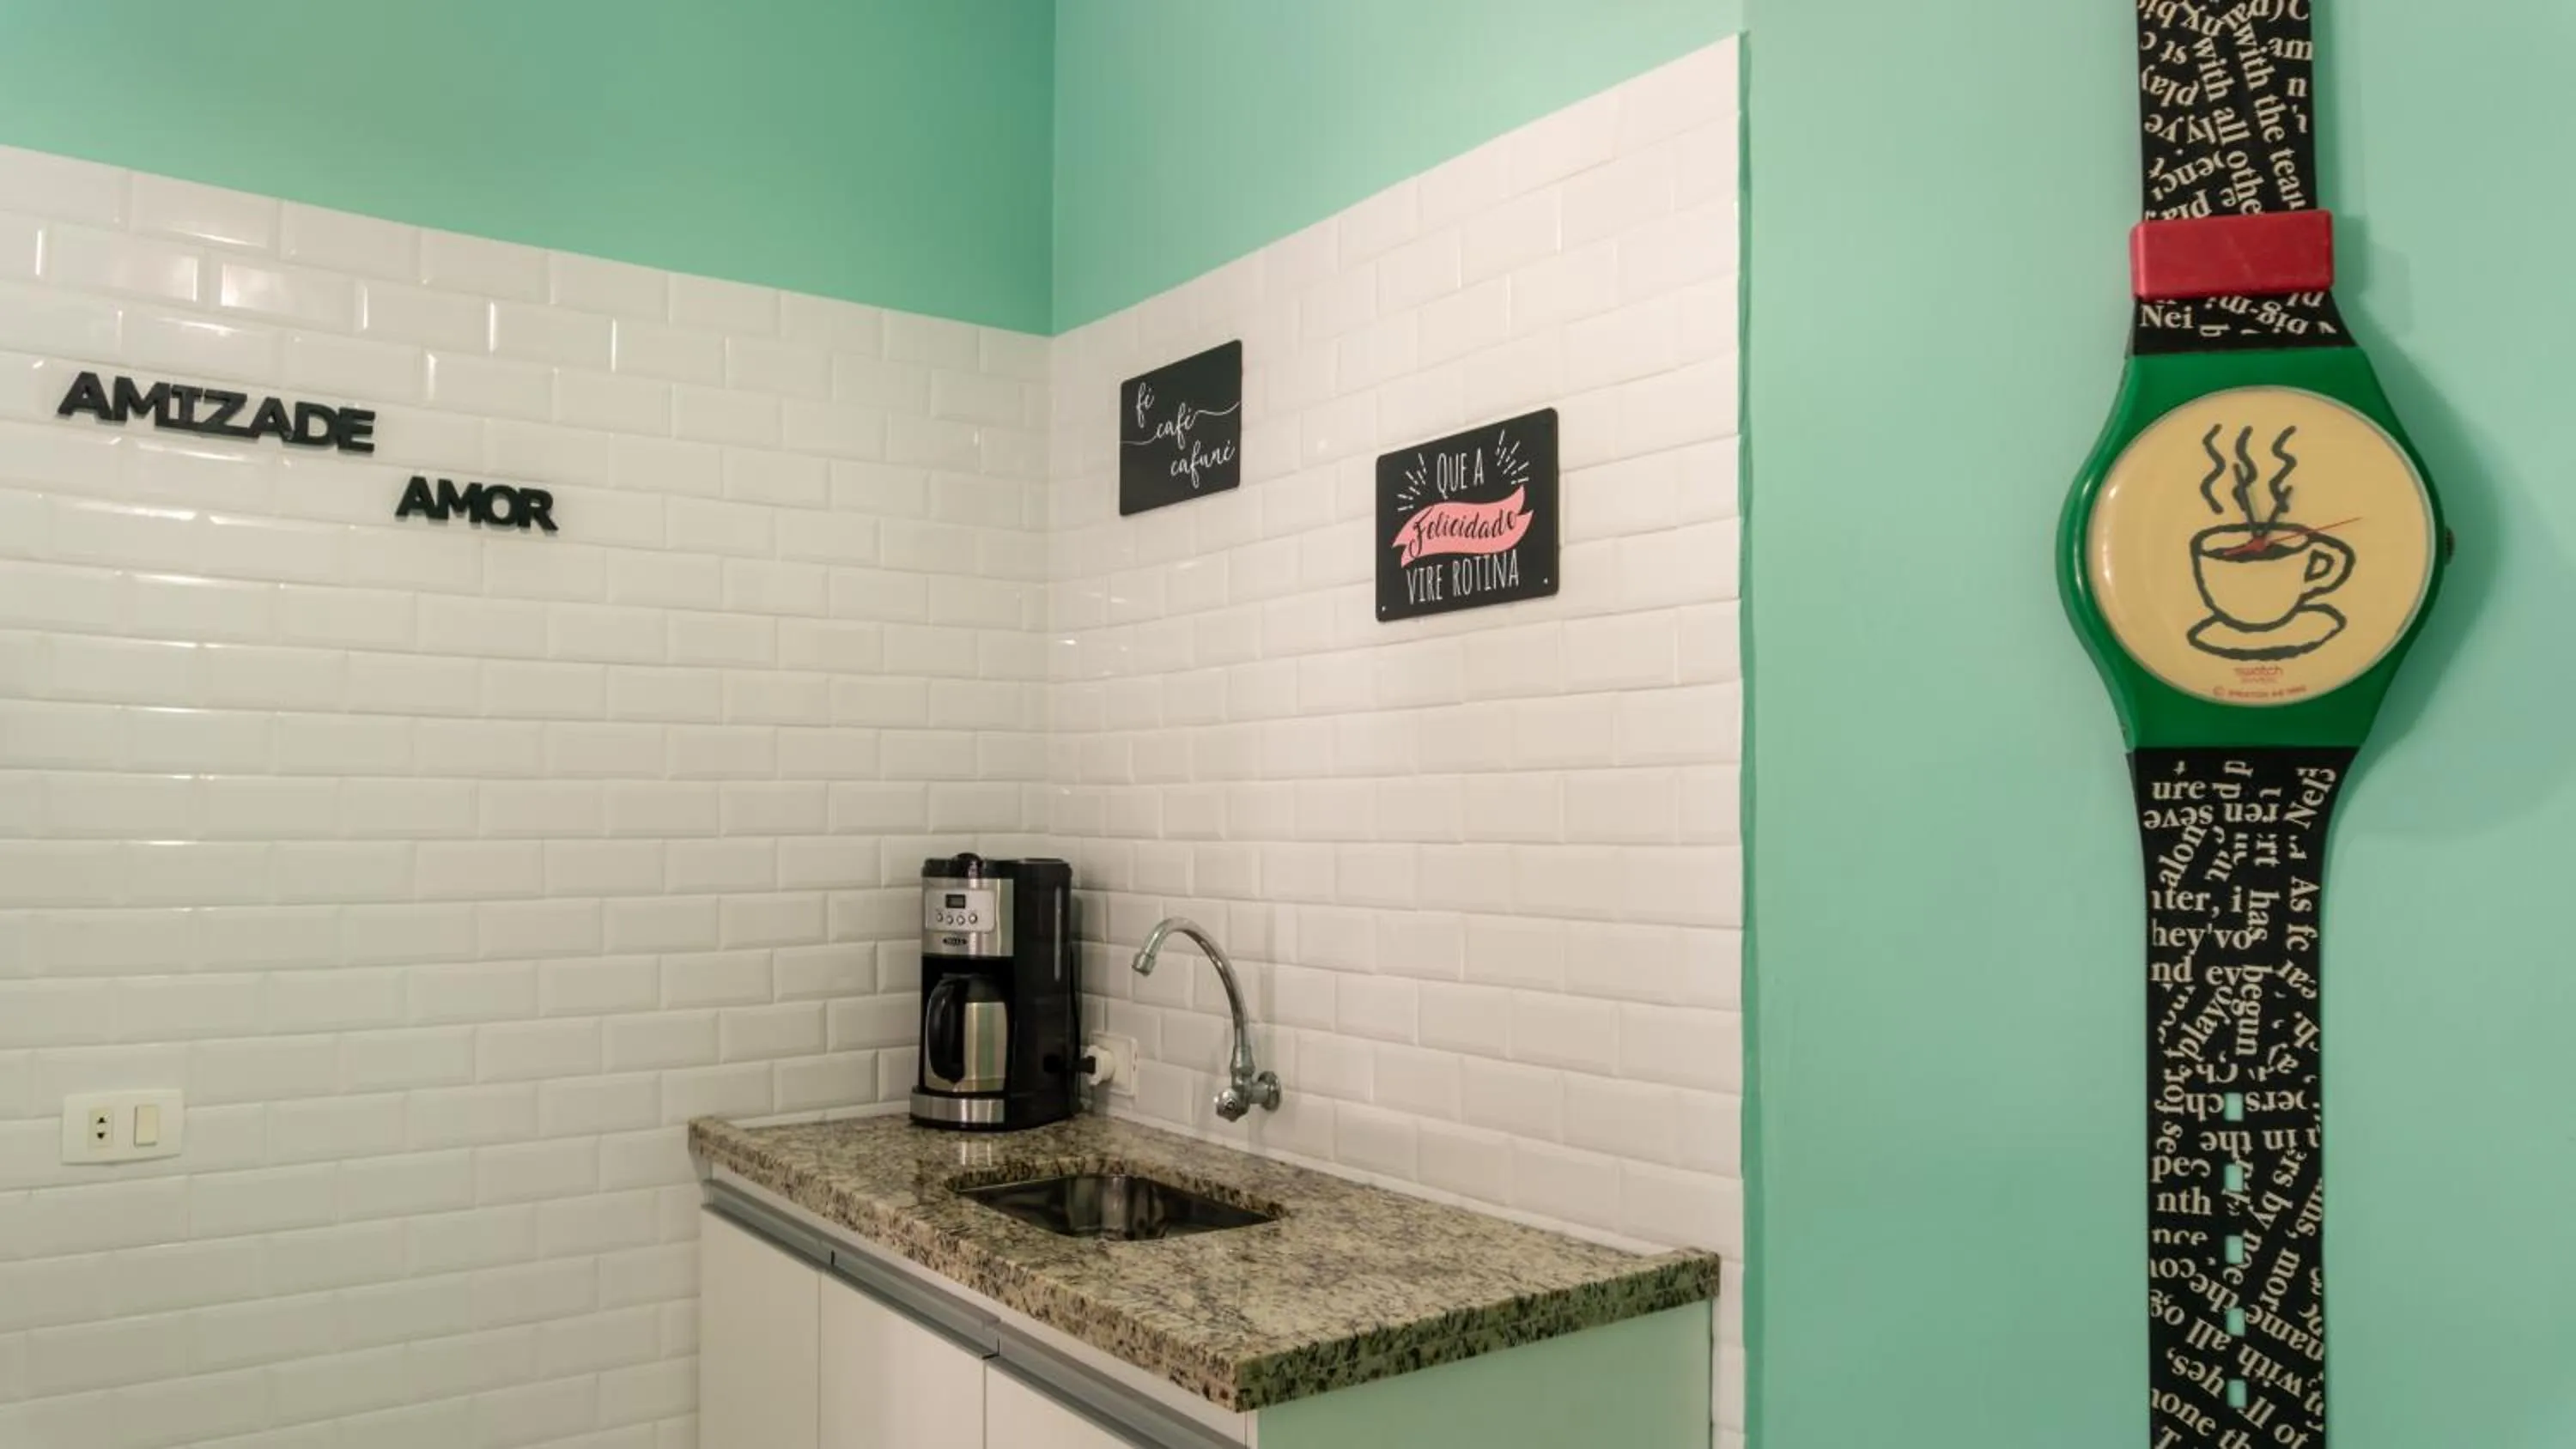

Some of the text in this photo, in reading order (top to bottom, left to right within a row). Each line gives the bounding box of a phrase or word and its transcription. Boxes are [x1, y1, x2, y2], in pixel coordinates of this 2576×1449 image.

[2191, 36, 2235, 102] with
[2233, 22, 2276, 90] with
[2212, 106, 2251, 147] all
[2253, 94, 2287, 143] the
[57, 370, 376, 452] AMIZADE
[1437, 446, 1485, 500] QUE A
[395, 475, 559, 531] AMOR
[1406, 549, 1520, 605] VIRE ROTINA
[2142, 802, 2281, 830] ren seve
[2152, 779, 2207, 800] ure
[2247, 889, 2281, 941] has
[2150, 955, 2193, 983] nd
[2232, 964, 2275, 1056] begun
[2199, 1130, 2253, 1159] the
[2156, 1186, 2213, 1216] nth
[2258, 1246, 2300, 1312] mor
[2185, 1316, 2232, 1350] all
[2245, 1303, 2324, 1361] name
[2237, 1343, 2304, 1397] with
